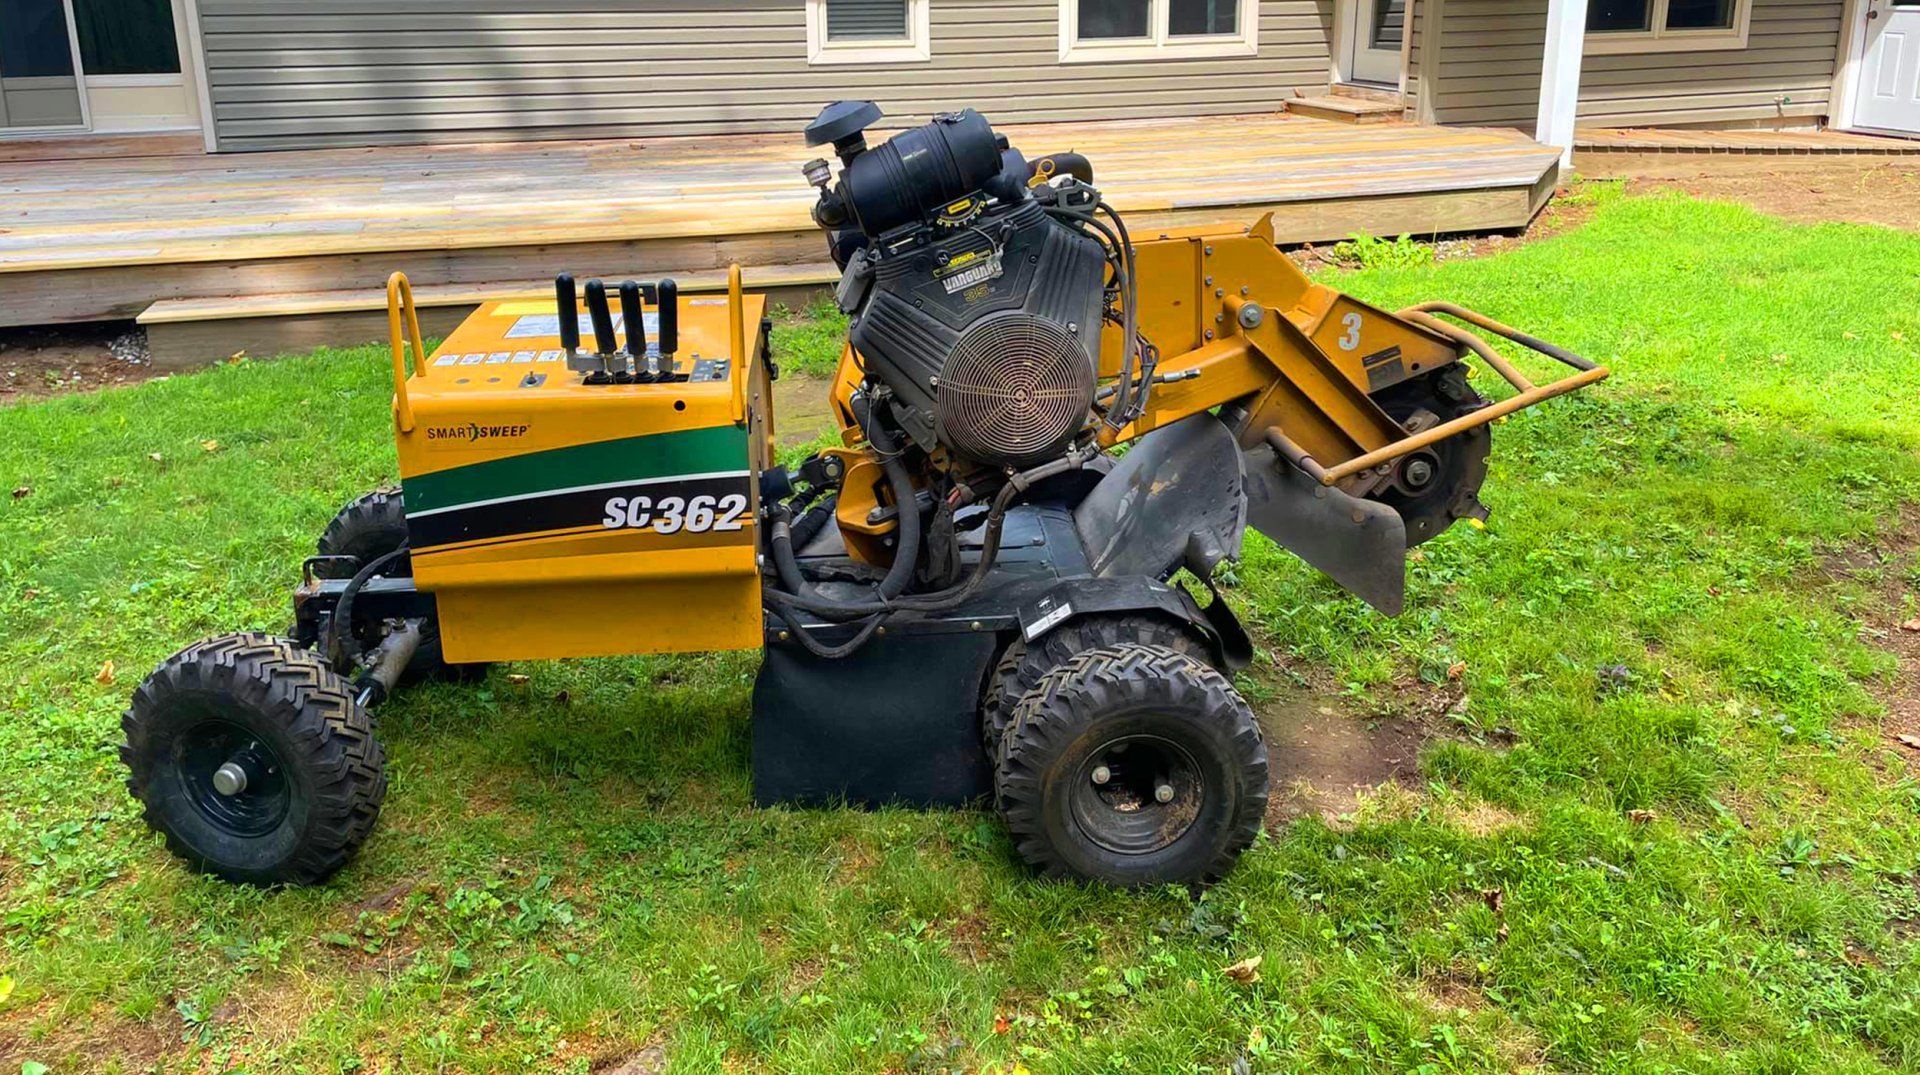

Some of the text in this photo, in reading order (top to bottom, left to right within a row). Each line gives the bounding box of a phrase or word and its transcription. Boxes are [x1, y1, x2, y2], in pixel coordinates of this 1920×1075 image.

[1338, 312, 1362, 351] 3
[427, 425, 528, 439] SMART SWEEP
